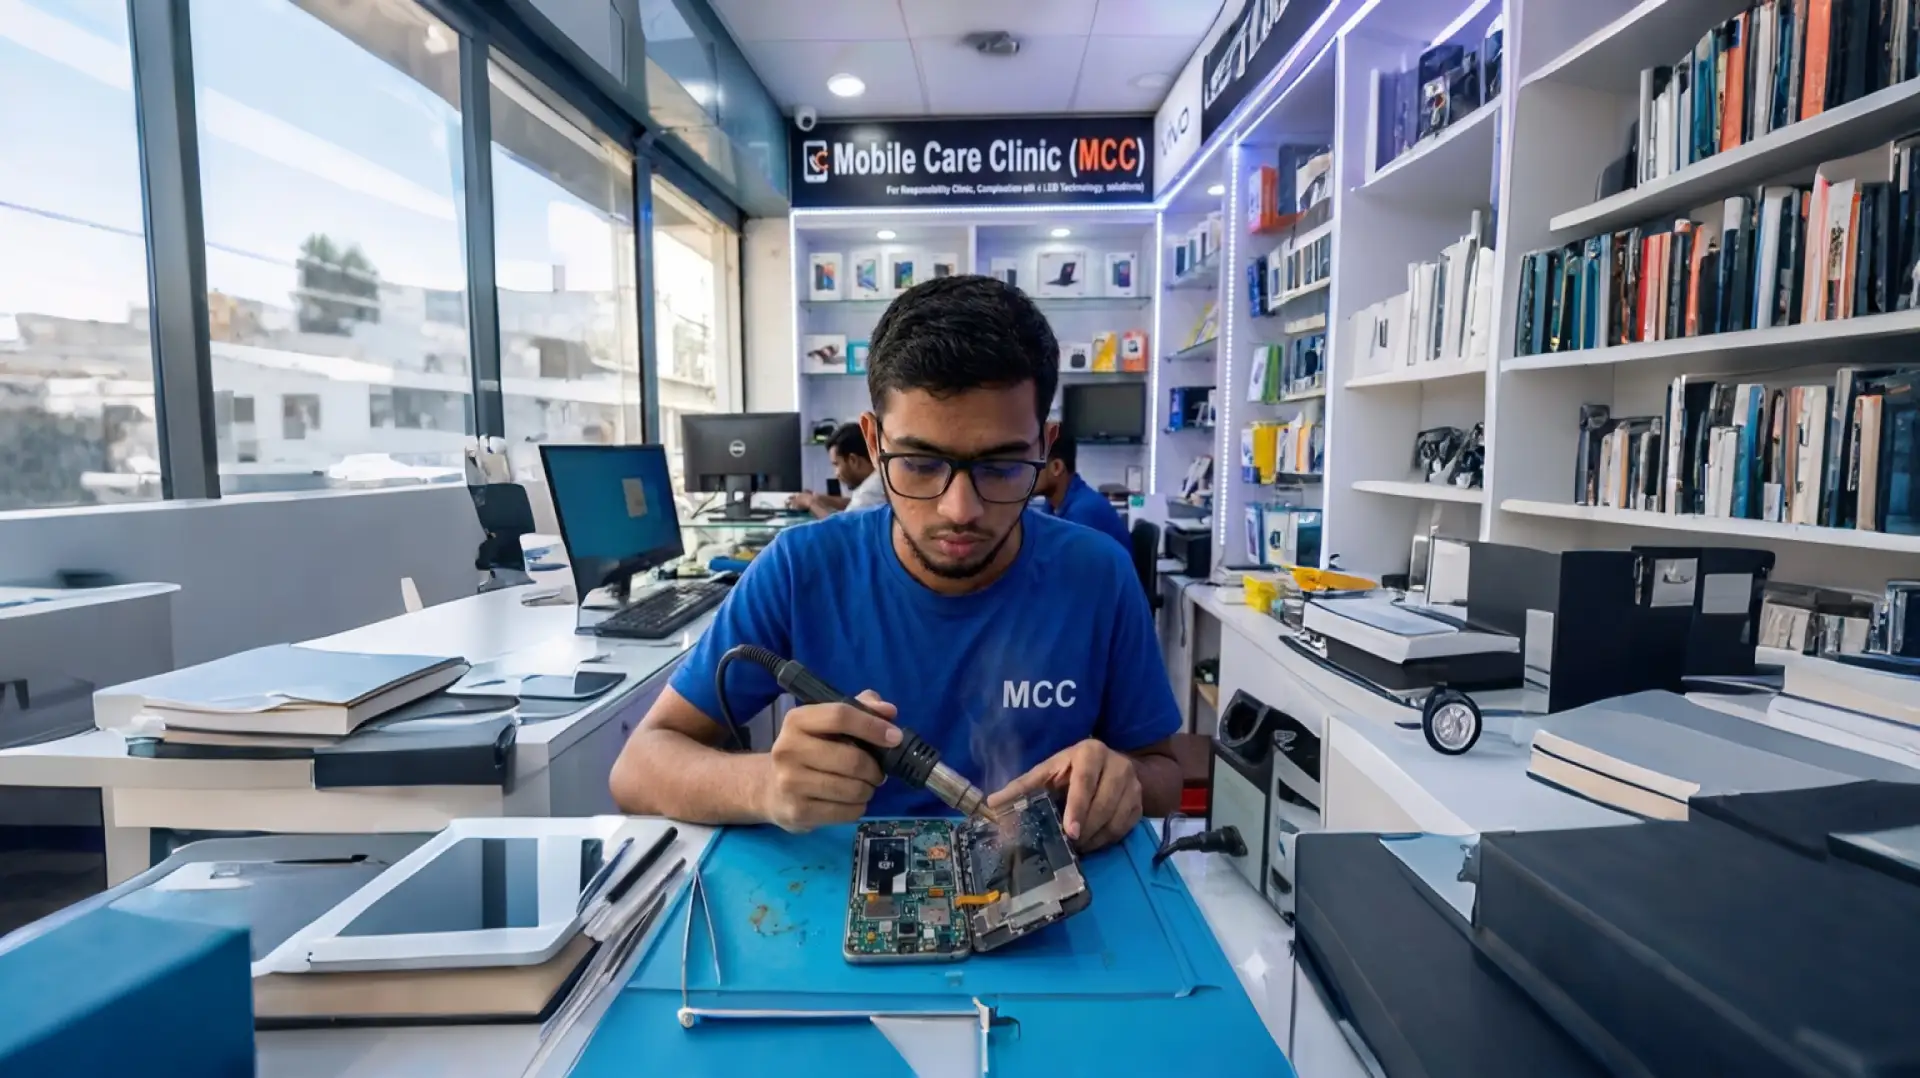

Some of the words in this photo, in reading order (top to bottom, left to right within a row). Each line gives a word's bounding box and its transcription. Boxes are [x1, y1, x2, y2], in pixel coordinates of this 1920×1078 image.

[834, 141, 916, 175] Mobile
[923, 140, 982, 174] Care
[989, 138, 1062, 173] Clinic
[1069, 136, 1145, 178] (MCC)
[1002, 679, 1077, 708] MCC
